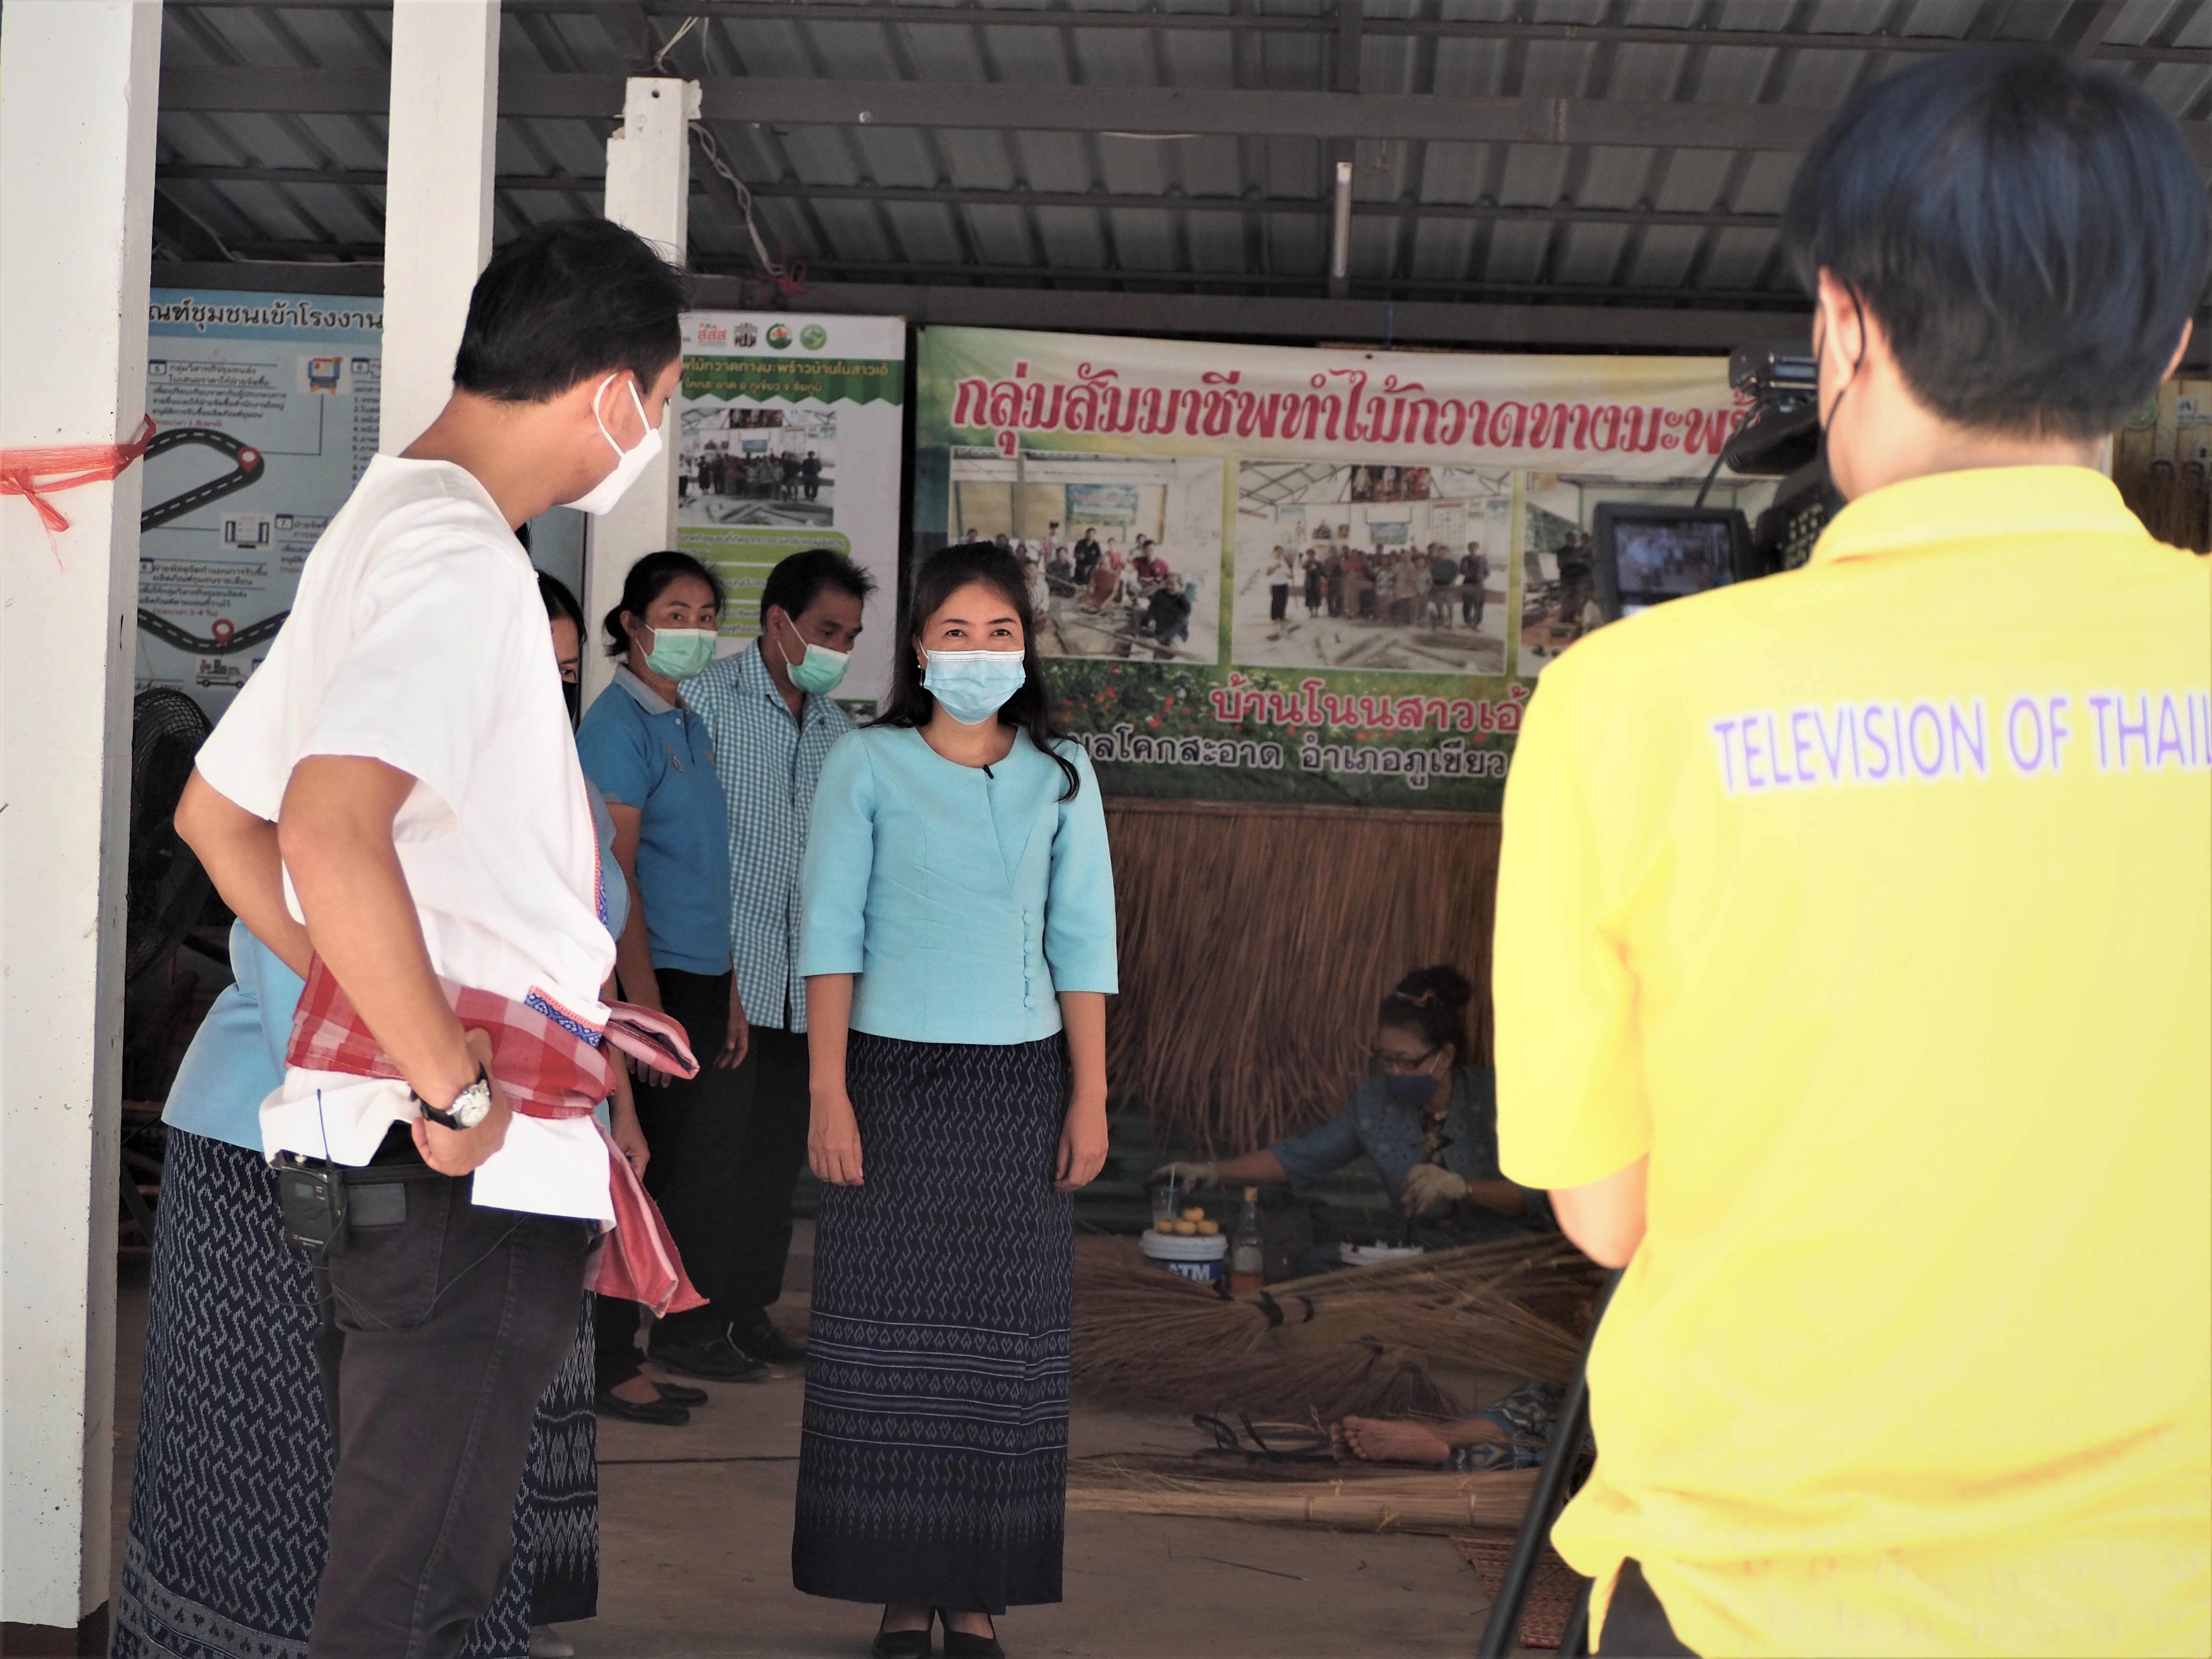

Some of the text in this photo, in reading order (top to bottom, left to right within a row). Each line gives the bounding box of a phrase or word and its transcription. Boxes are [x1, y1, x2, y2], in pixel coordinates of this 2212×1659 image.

[1210, 673, 1528, 731] บ้านโนนสาวเอ้
[1301, 733, 1507, 788] อำเภอภูเขียว
[1713, 702, 1985, 792] TELEVISION
[2008, 697, 2068, 771] OF
